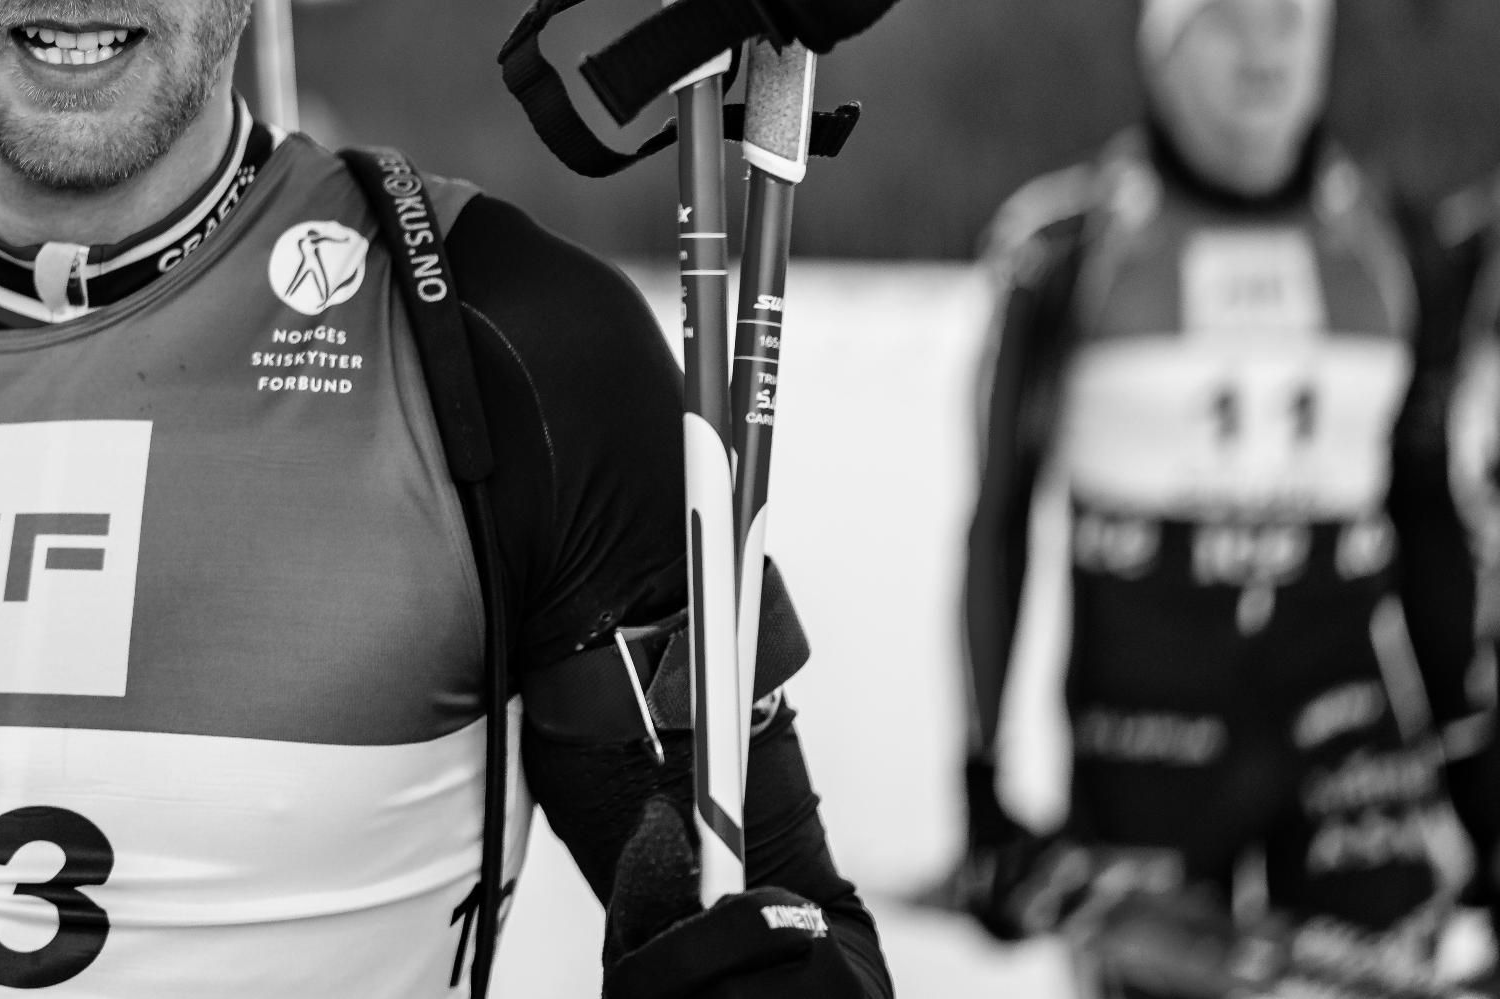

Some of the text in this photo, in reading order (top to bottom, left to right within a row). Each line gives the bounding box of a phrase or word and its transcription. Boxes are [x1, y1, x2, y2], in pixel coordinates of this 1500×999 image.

[158, 181, 239, 272] CRAFT
[272, 325, 347, 345] NORGES
[251, 350, 363, 369] SKISKYTTER
[257, 375, 353, 394] FORBUND
